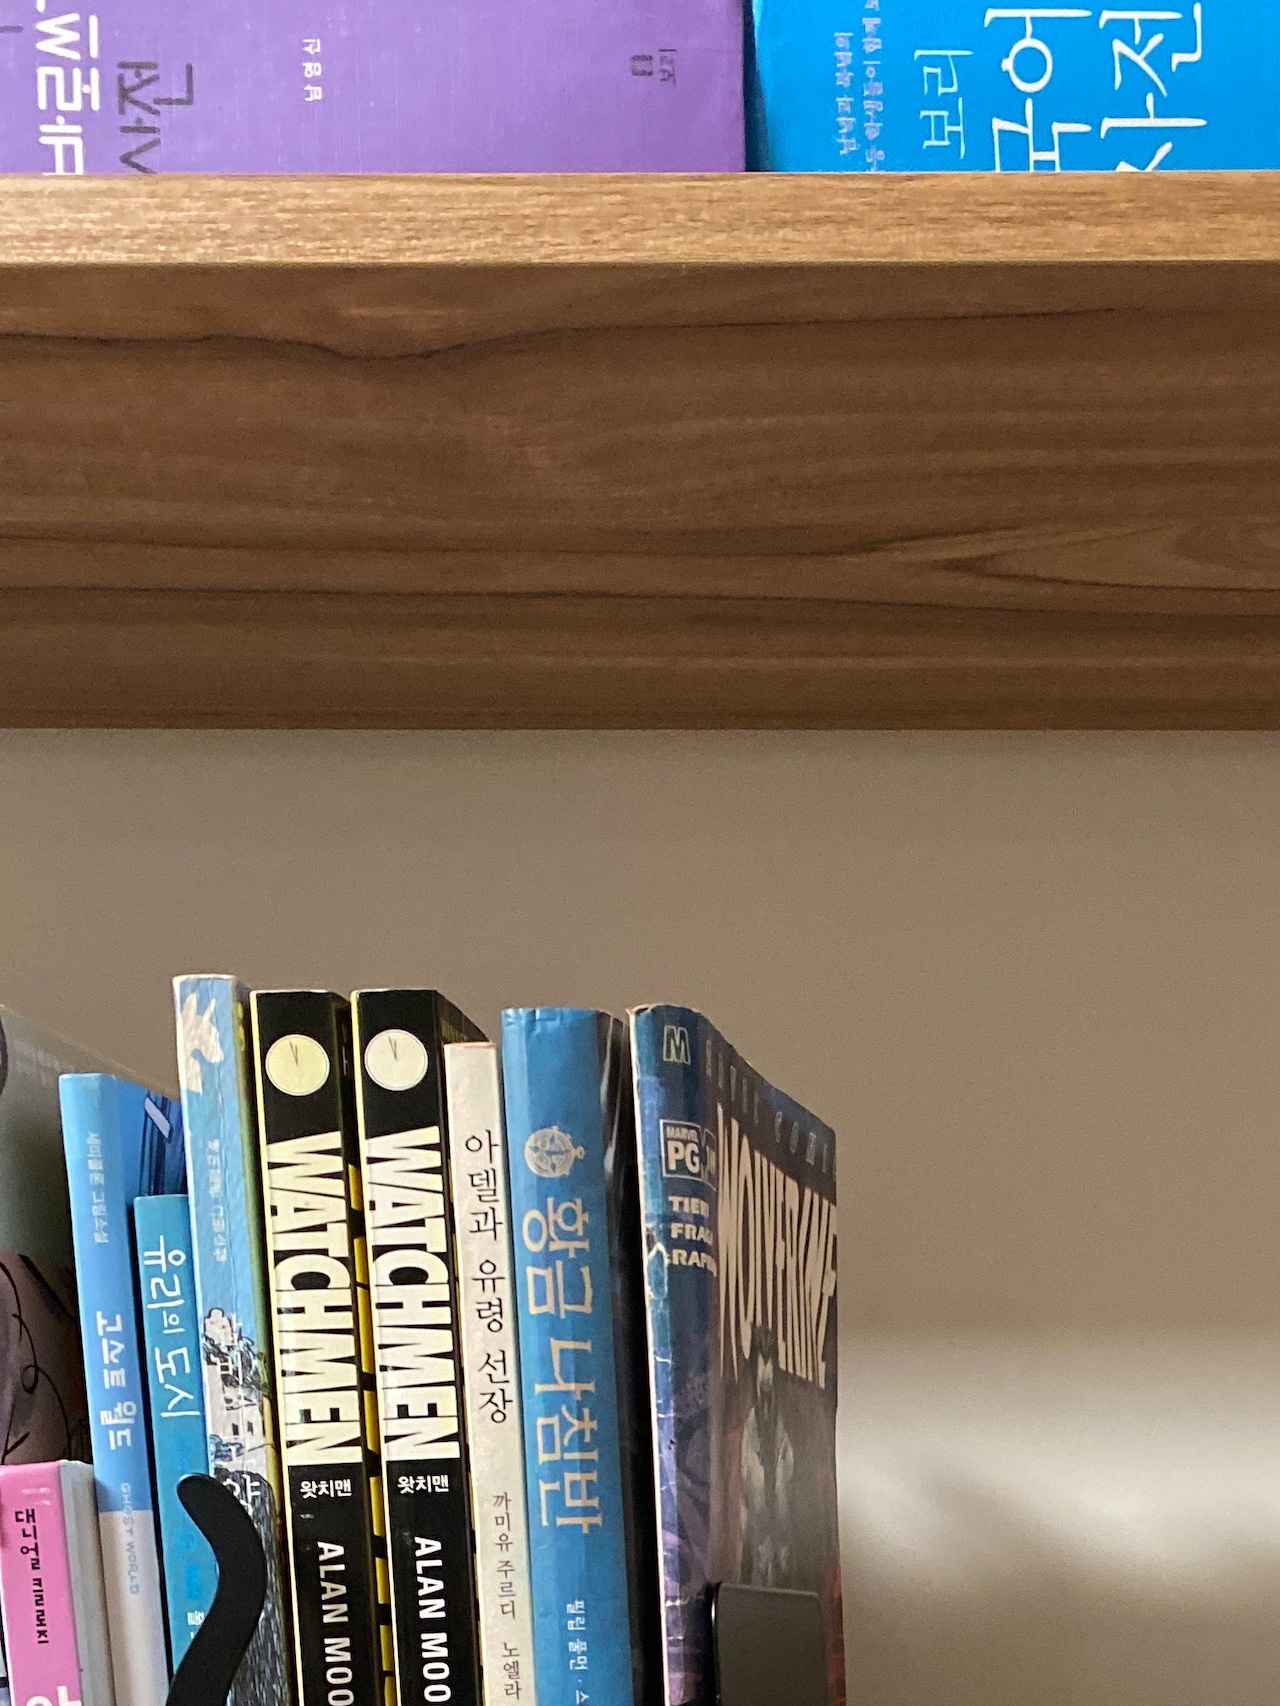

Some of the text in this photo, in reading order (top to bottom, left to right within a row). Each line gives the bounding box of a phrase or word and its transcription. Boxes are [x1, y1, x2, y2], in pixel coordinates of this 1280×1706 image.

[36, 0, 99, 175] 바로쓰
[118, 61, 195, 174] 사전
[912, 48, 974, 159] 보리
[983, 7, 1093, 172] 국어
[1100, 2, 1208, 172] 사전
[667, 1140, 703, 1176] PG
[142, 1234, 201, 1418] 유리의 도시
[266, 1130, 363, 1465] WATCHMEN
[365, 1125, 461, 1460] WATCHMEN
[464, 1129, 514, 1425] 아델과 유령 선장
[95, 1309, 138, 1451] 고스트 월드
[522, 1195, 603, 1534] 황금 나침반
[299, 1480, 353, 1499] 왓치맨
[397, 1475, 449, 1495] 왓치맨
[316, 1541, 349, 1624] ALAN
[414, 1536, 446, 1618] ALAN
